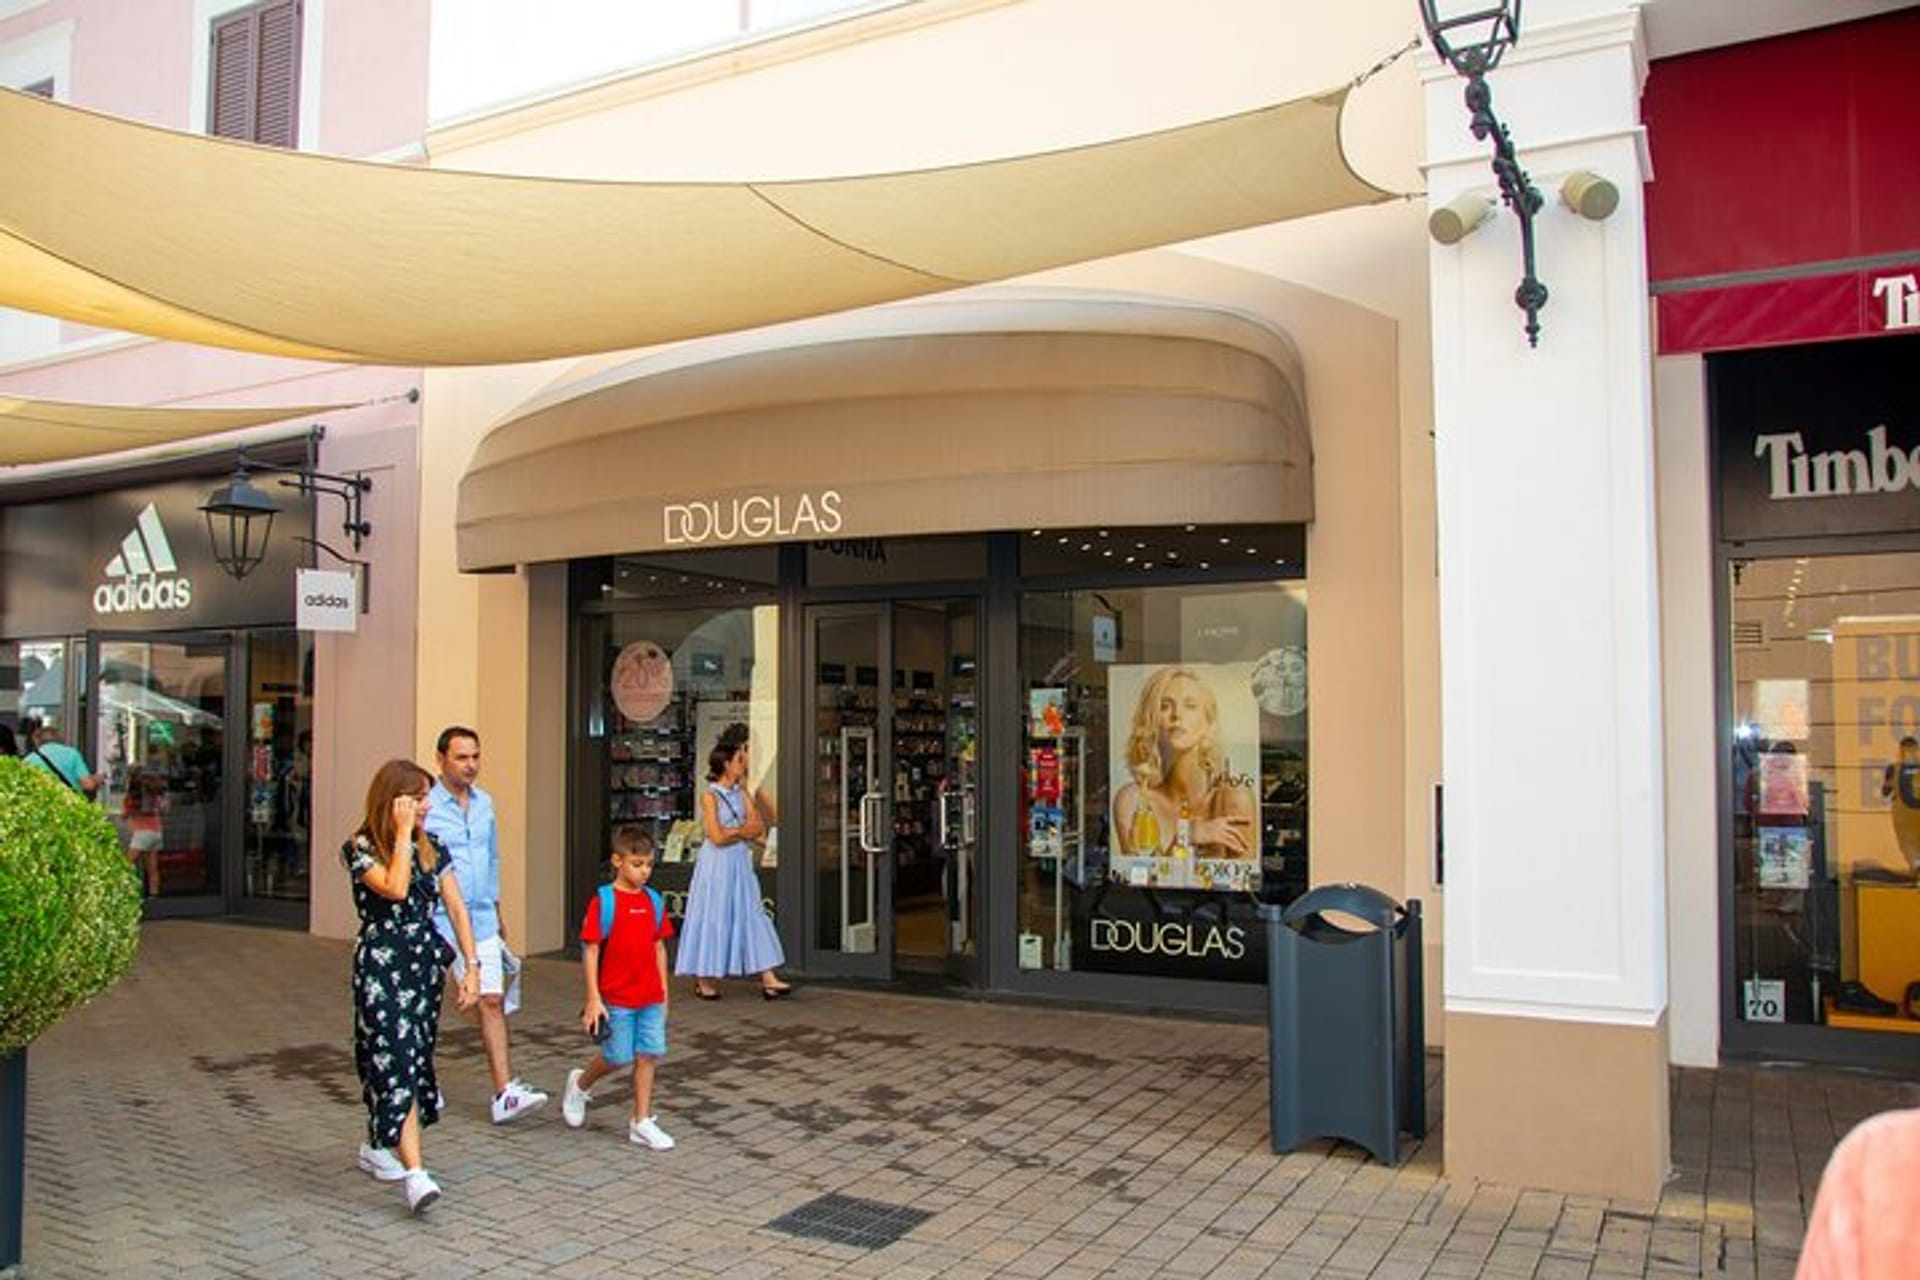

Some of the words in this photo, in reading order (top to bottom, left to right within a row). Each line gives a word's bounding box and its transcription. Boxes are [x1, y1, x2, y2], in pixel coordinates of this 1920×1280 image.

[663, 490, 842, 543] DOUGLAS
[93, 573, 191, 613] adidas
[304, 593, 349, 610] adidas
[1090, 919, 1246, 960] DOUGLAS
[1749, 999, 1778, 1017] 70
